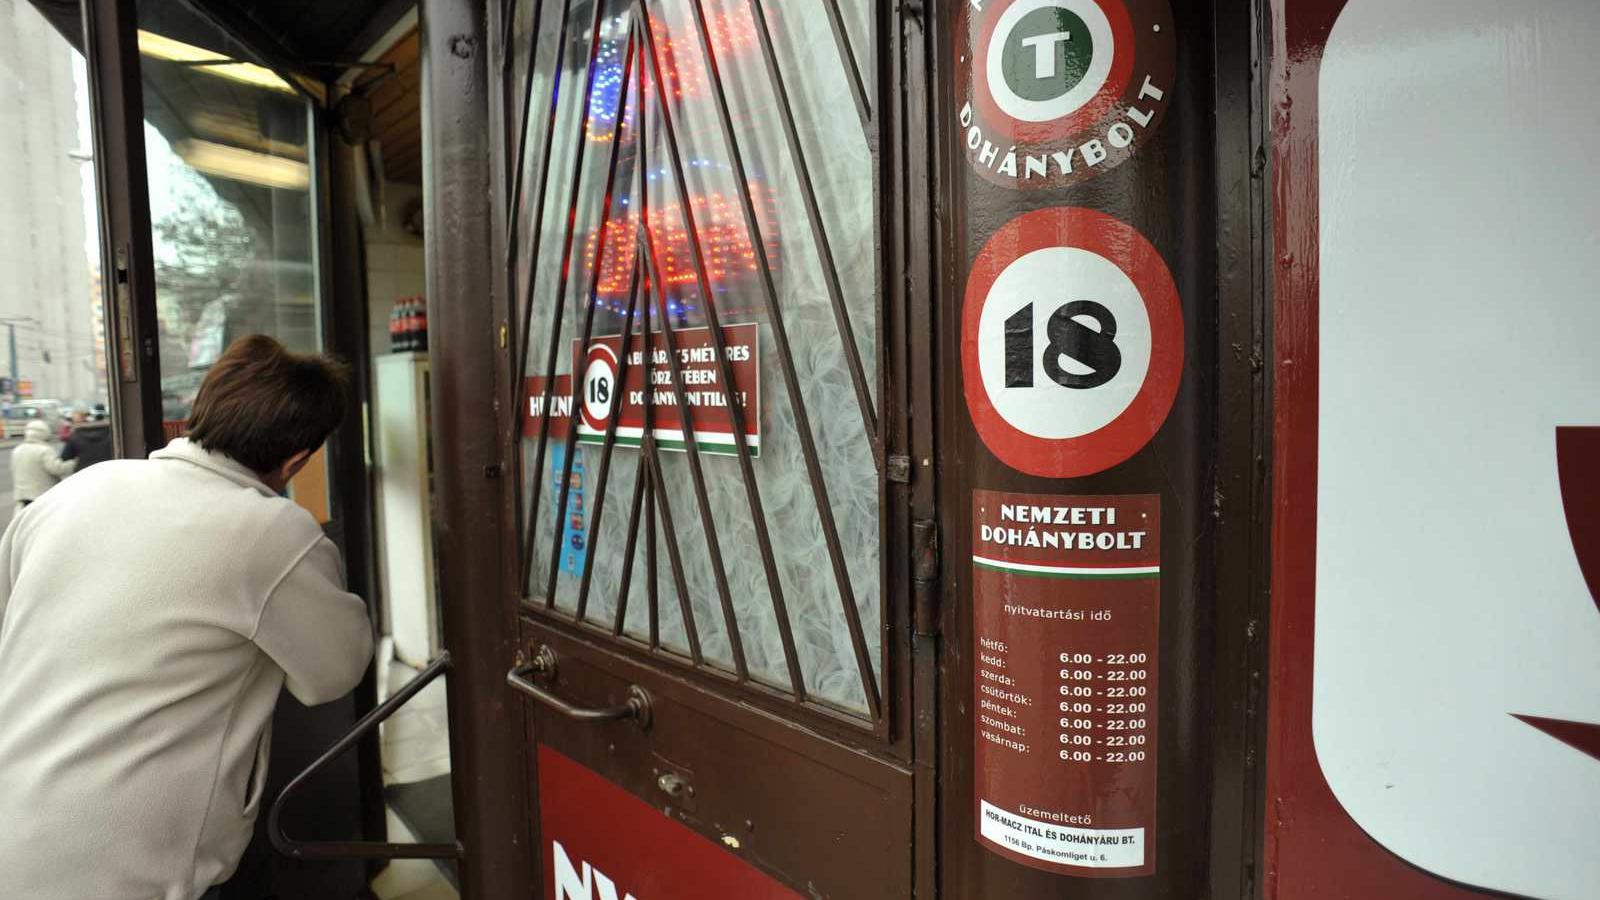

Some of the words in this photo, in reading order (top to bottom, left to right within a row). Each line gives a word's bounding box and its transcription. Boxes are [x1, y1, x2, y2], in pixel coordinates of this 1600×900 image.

[1022, 31, 1070, 79] T
[960, 74, 1164, 179] DOHÁNYBOLT
[690, 342, 750, 362] MÉTRES
[1004, 300, 1122, 390] 18
[648, 365, 717, 385] ÖRZTÉBEN
[590, 376, 609, 404] 18
[630, 387, 701, 406] DOÁNYNI
[702, 391, 747, 408] TIL!
[1001, 504, 1116, 525] NEMZETI
[981, 525, 1146, 550] DOHÁNYBOLT
[1004, 604, 1084, 620] nyitvatartási
[1090, 609, 1112, 621] idő
[980, 636, 1008, 653] hétfő:
[1059, 653, 1092, 664] 6.00
[1106, 653, 1146, 664] 22.00
[980, 653, 1006, 668] kedd:
[1059, 670, 1092, 680] 6.00
[1106, 670, 1146, 680] 22.00
[980, 668, 1015, 686] szerda:
[1059, 686, 1092, 696] 6.00
[1106, 687, 1146, 697] 22.00
[980, 683, 1032, 706] csütörtök:
[1059, 702, 1092, 713] 6.00
[1106, 703, 1146, 714] 22.00
[981, 699, 1017, 718] péntek:
[1059, 718, 1092, 729] 6.00
[1106, 719, 1146, 729] 22.00
[980, 714, 1026, 736] szombat:
[1059, 734, 1092, 745] 6.00
[1106, 735, 1146, 746] 22.00
[981, 729, 1030, 753] vasárnap:
[1059, 750, 1092, 761] 6.00
[1106, 751, 1146, 762] 22.00
[985, 809, 1022, 831] HOR-MACZ
[1024, 825, 1043, 837] ITAL
[1045, 829, 1057, 840] ÉS
[1060, 832, 1119, 845] DOHÁNYÁRU
[1122, 836, 1135, 844] BT.
[1019, 804, 1092, 825] üzemeltető
[1021, 840, 1034, 851] Bp.
[1036, 845, 1087, 861] Páskomliget
